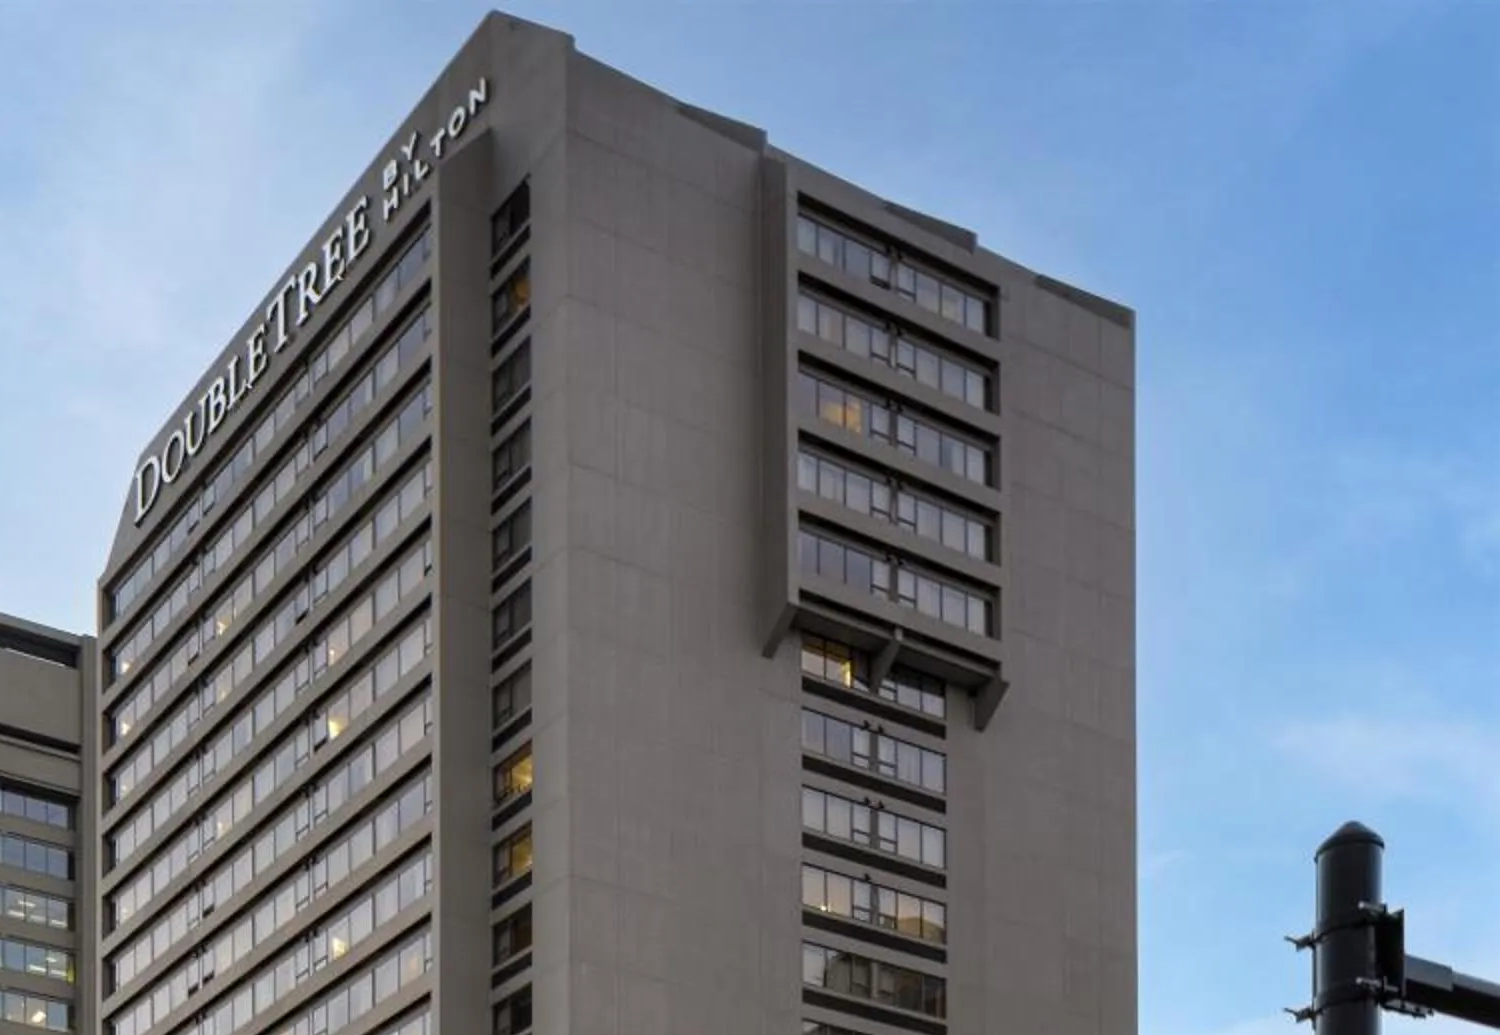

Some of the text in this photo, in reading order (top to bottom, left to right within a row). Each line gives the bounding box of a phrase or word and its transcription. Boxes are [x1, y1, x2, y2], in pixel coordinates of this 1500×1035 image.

[383, 76, 487, 221] HILTON
[383, 131, 418, 191] BY
[132, 195, 371, 525] DOUBLETREE
